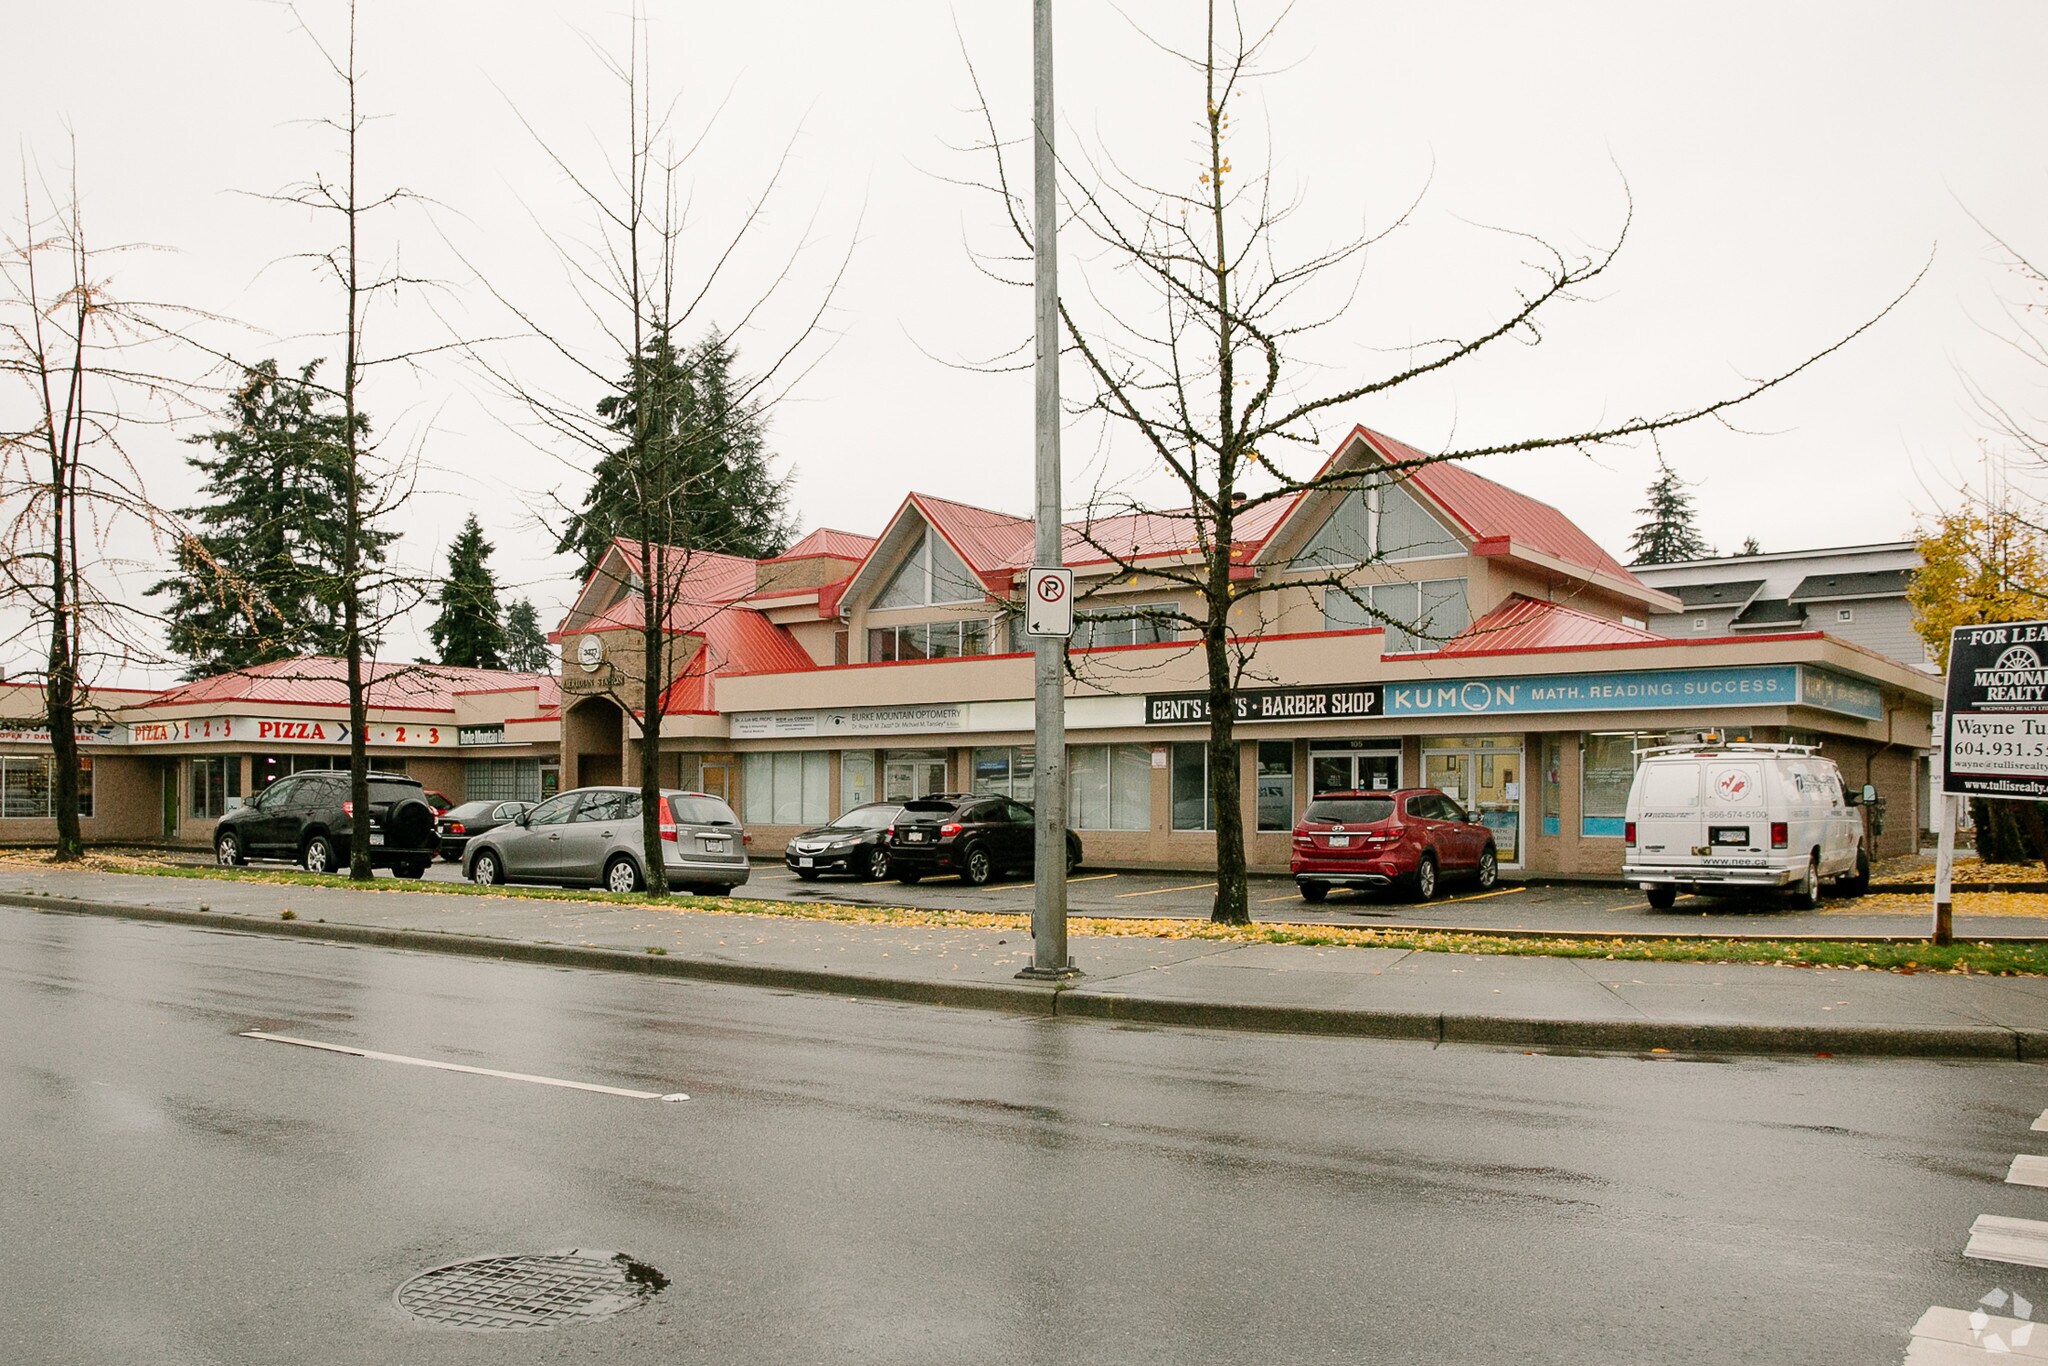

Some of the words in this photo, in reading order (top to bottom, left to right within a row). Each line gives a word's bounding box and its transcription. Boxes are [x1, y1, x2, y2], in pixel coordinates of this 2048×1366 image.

[1970, 629, 2007, 646] FOR
[1532, 687, 1585, 700] MATH.
[1590, 683, 1679, 698] READING.
[1684, 679, 1784, 695] SUCCESS.
[1987, 686, 2046, 701] REALTY
[1152, 699, 1201, 720] GENT'S
[1262, 694, 1327, 716] BARBER
[1331, 692, 1375, 713] SHOP
[852, 712, 874, 721] BURKE
[875, 711, 914, 720] MOUNTAIN
[915, 709, 961, 719] OPTOMETRY
[0, 732, 22, 740] OPEN
[134, 724, 167, 741] PIZZA
[184, 722, 190, 739] 1
[204, 720, 210, 737] 2
[224, 719, 231, 737] 3
[258, 721, 325, 740] PIZZA
[396, 727, 406, 742] 2
[429, 728, 439, 744] 3
[1957, 719, 2015, 737] Wayne
[2021, 719, 2048, 735] Tu
[1350, 741, 1363, 749] 105
